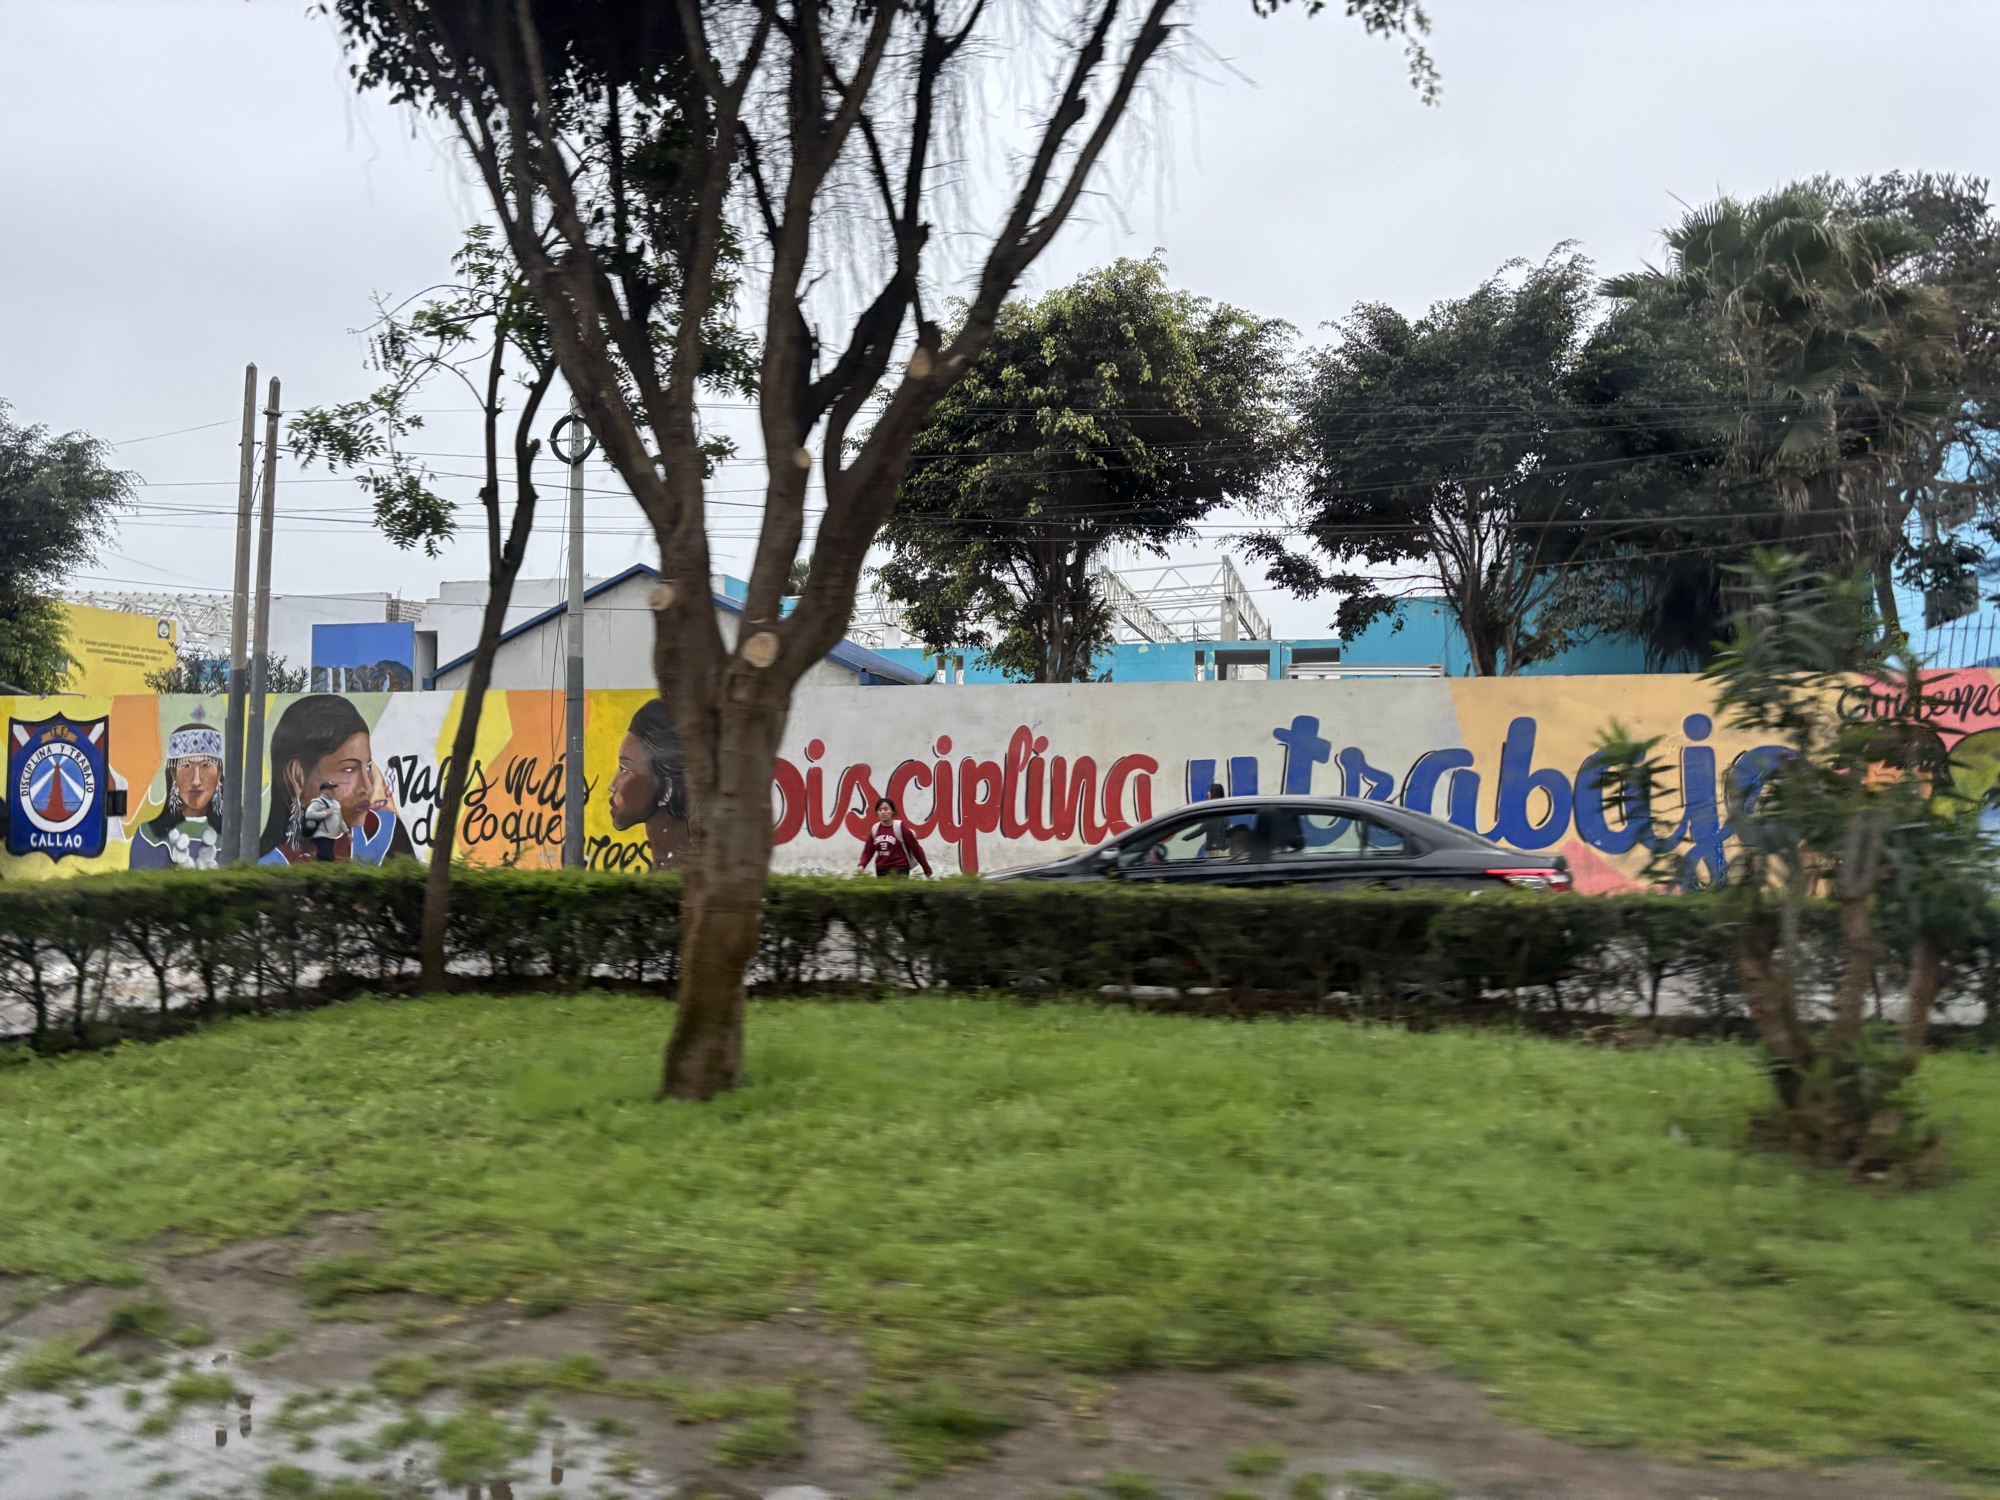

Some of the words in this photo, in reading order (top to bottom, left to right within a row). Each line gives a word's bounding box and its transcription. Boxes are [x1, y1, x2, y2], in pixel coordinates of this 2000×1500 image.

[21, 746, 52, 797] DISCIPLINA
[60, 744, 65, 753] Y
[69, 747, 95, 794] TRABAJO
[388, 755, 499, 809] Vals
[30, 833, 82, 847] CALLAO
